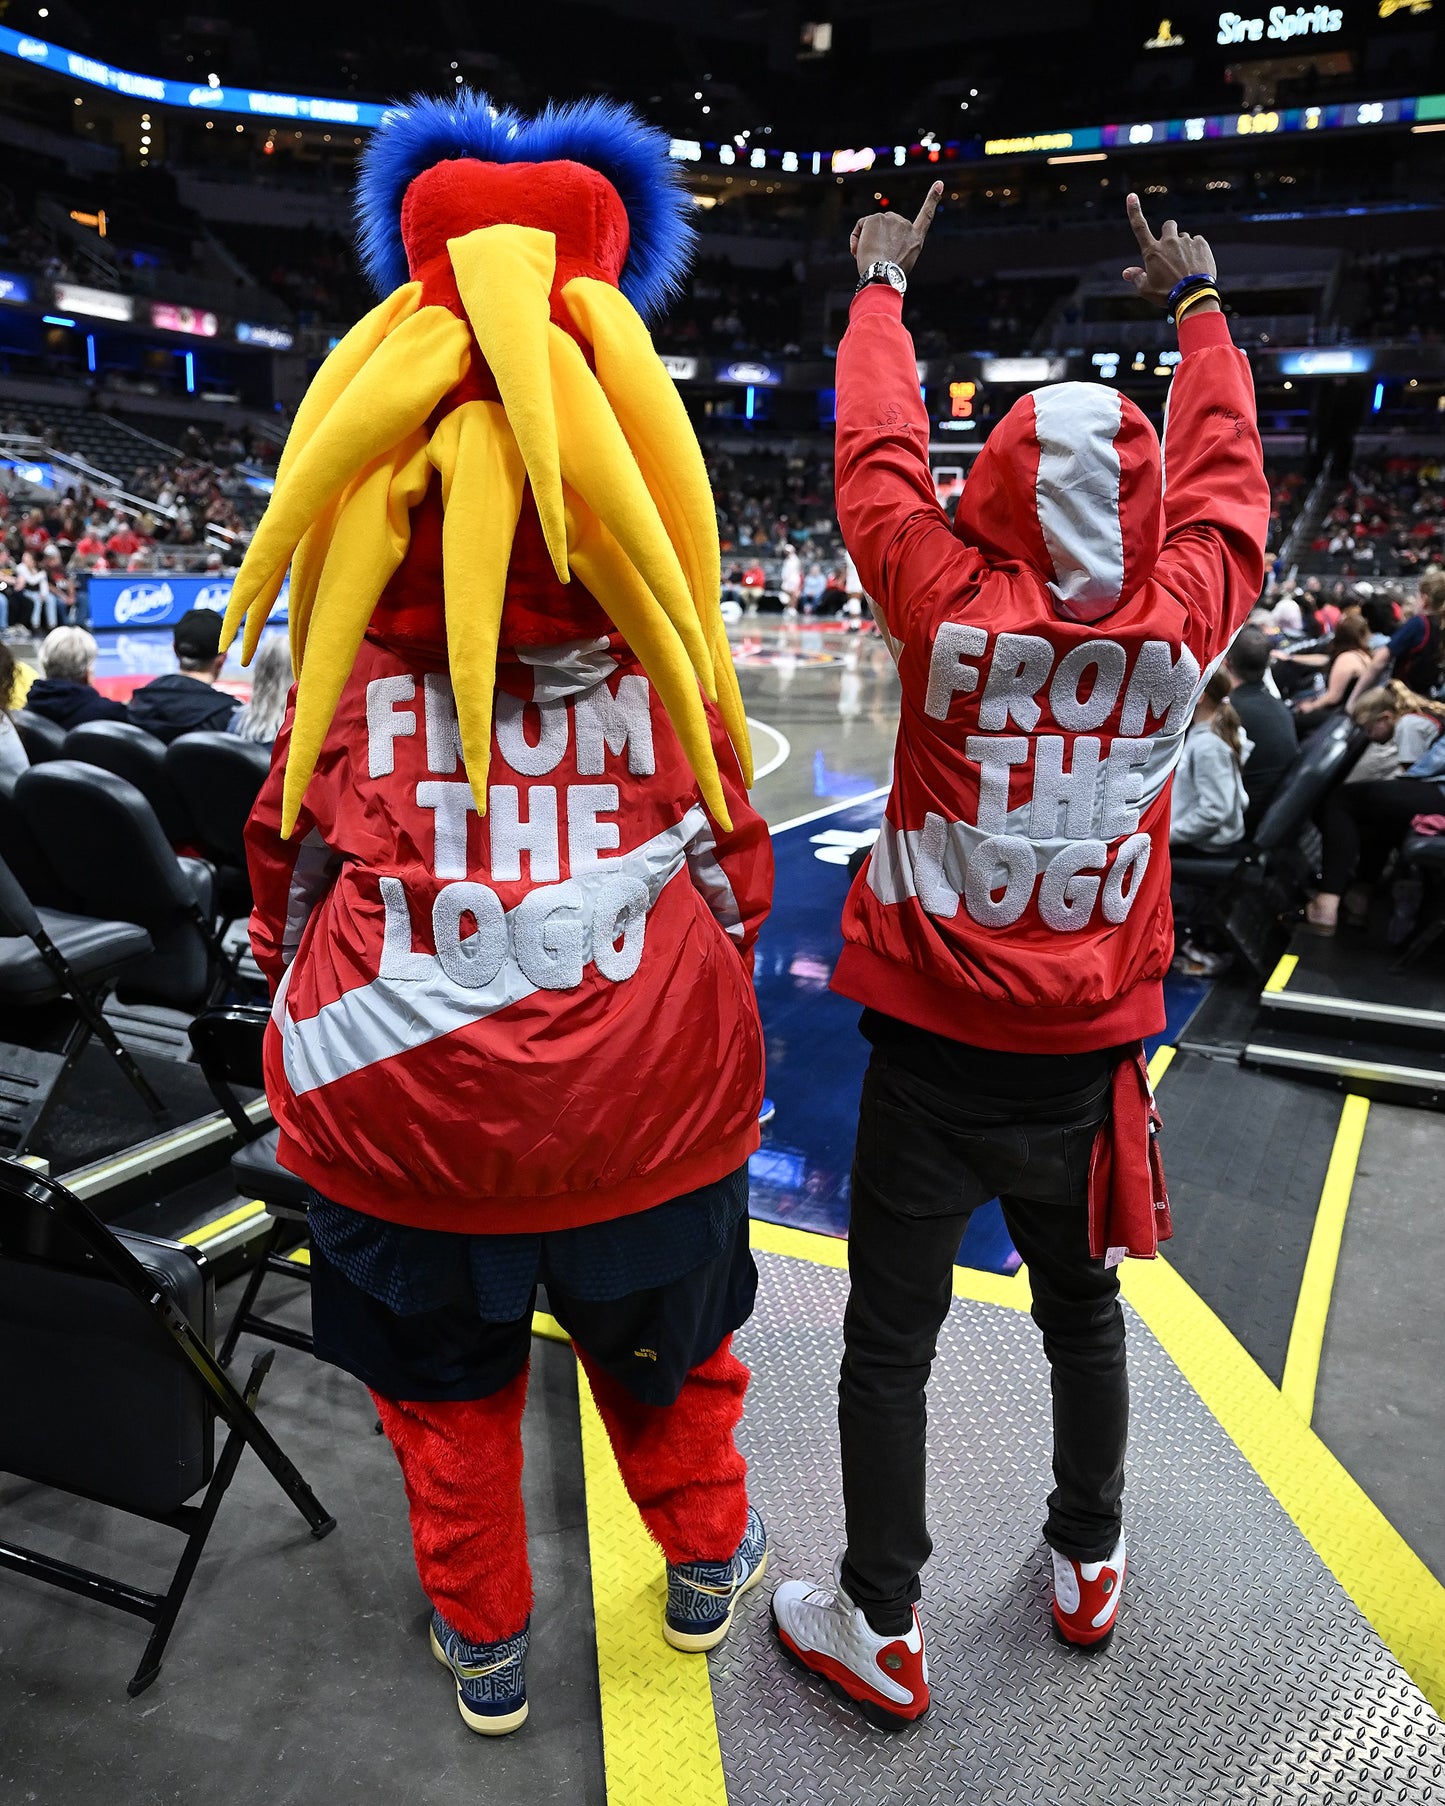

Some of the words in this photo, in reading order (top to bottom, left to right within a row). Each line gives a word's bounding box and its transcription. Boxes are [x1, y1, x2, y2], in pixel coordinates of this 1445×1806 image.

[1217, 12, 1265, 45] Sire
[1267, 4, 1344, 42] Spirits
[924, 621, 1201, 737] FROM
[416, 781, 623, 882] THE
[965, 735, 1155, 840] THE
[914, 811, 1152, 932] LOGO
[379, 876, 651, 990] LOGO
